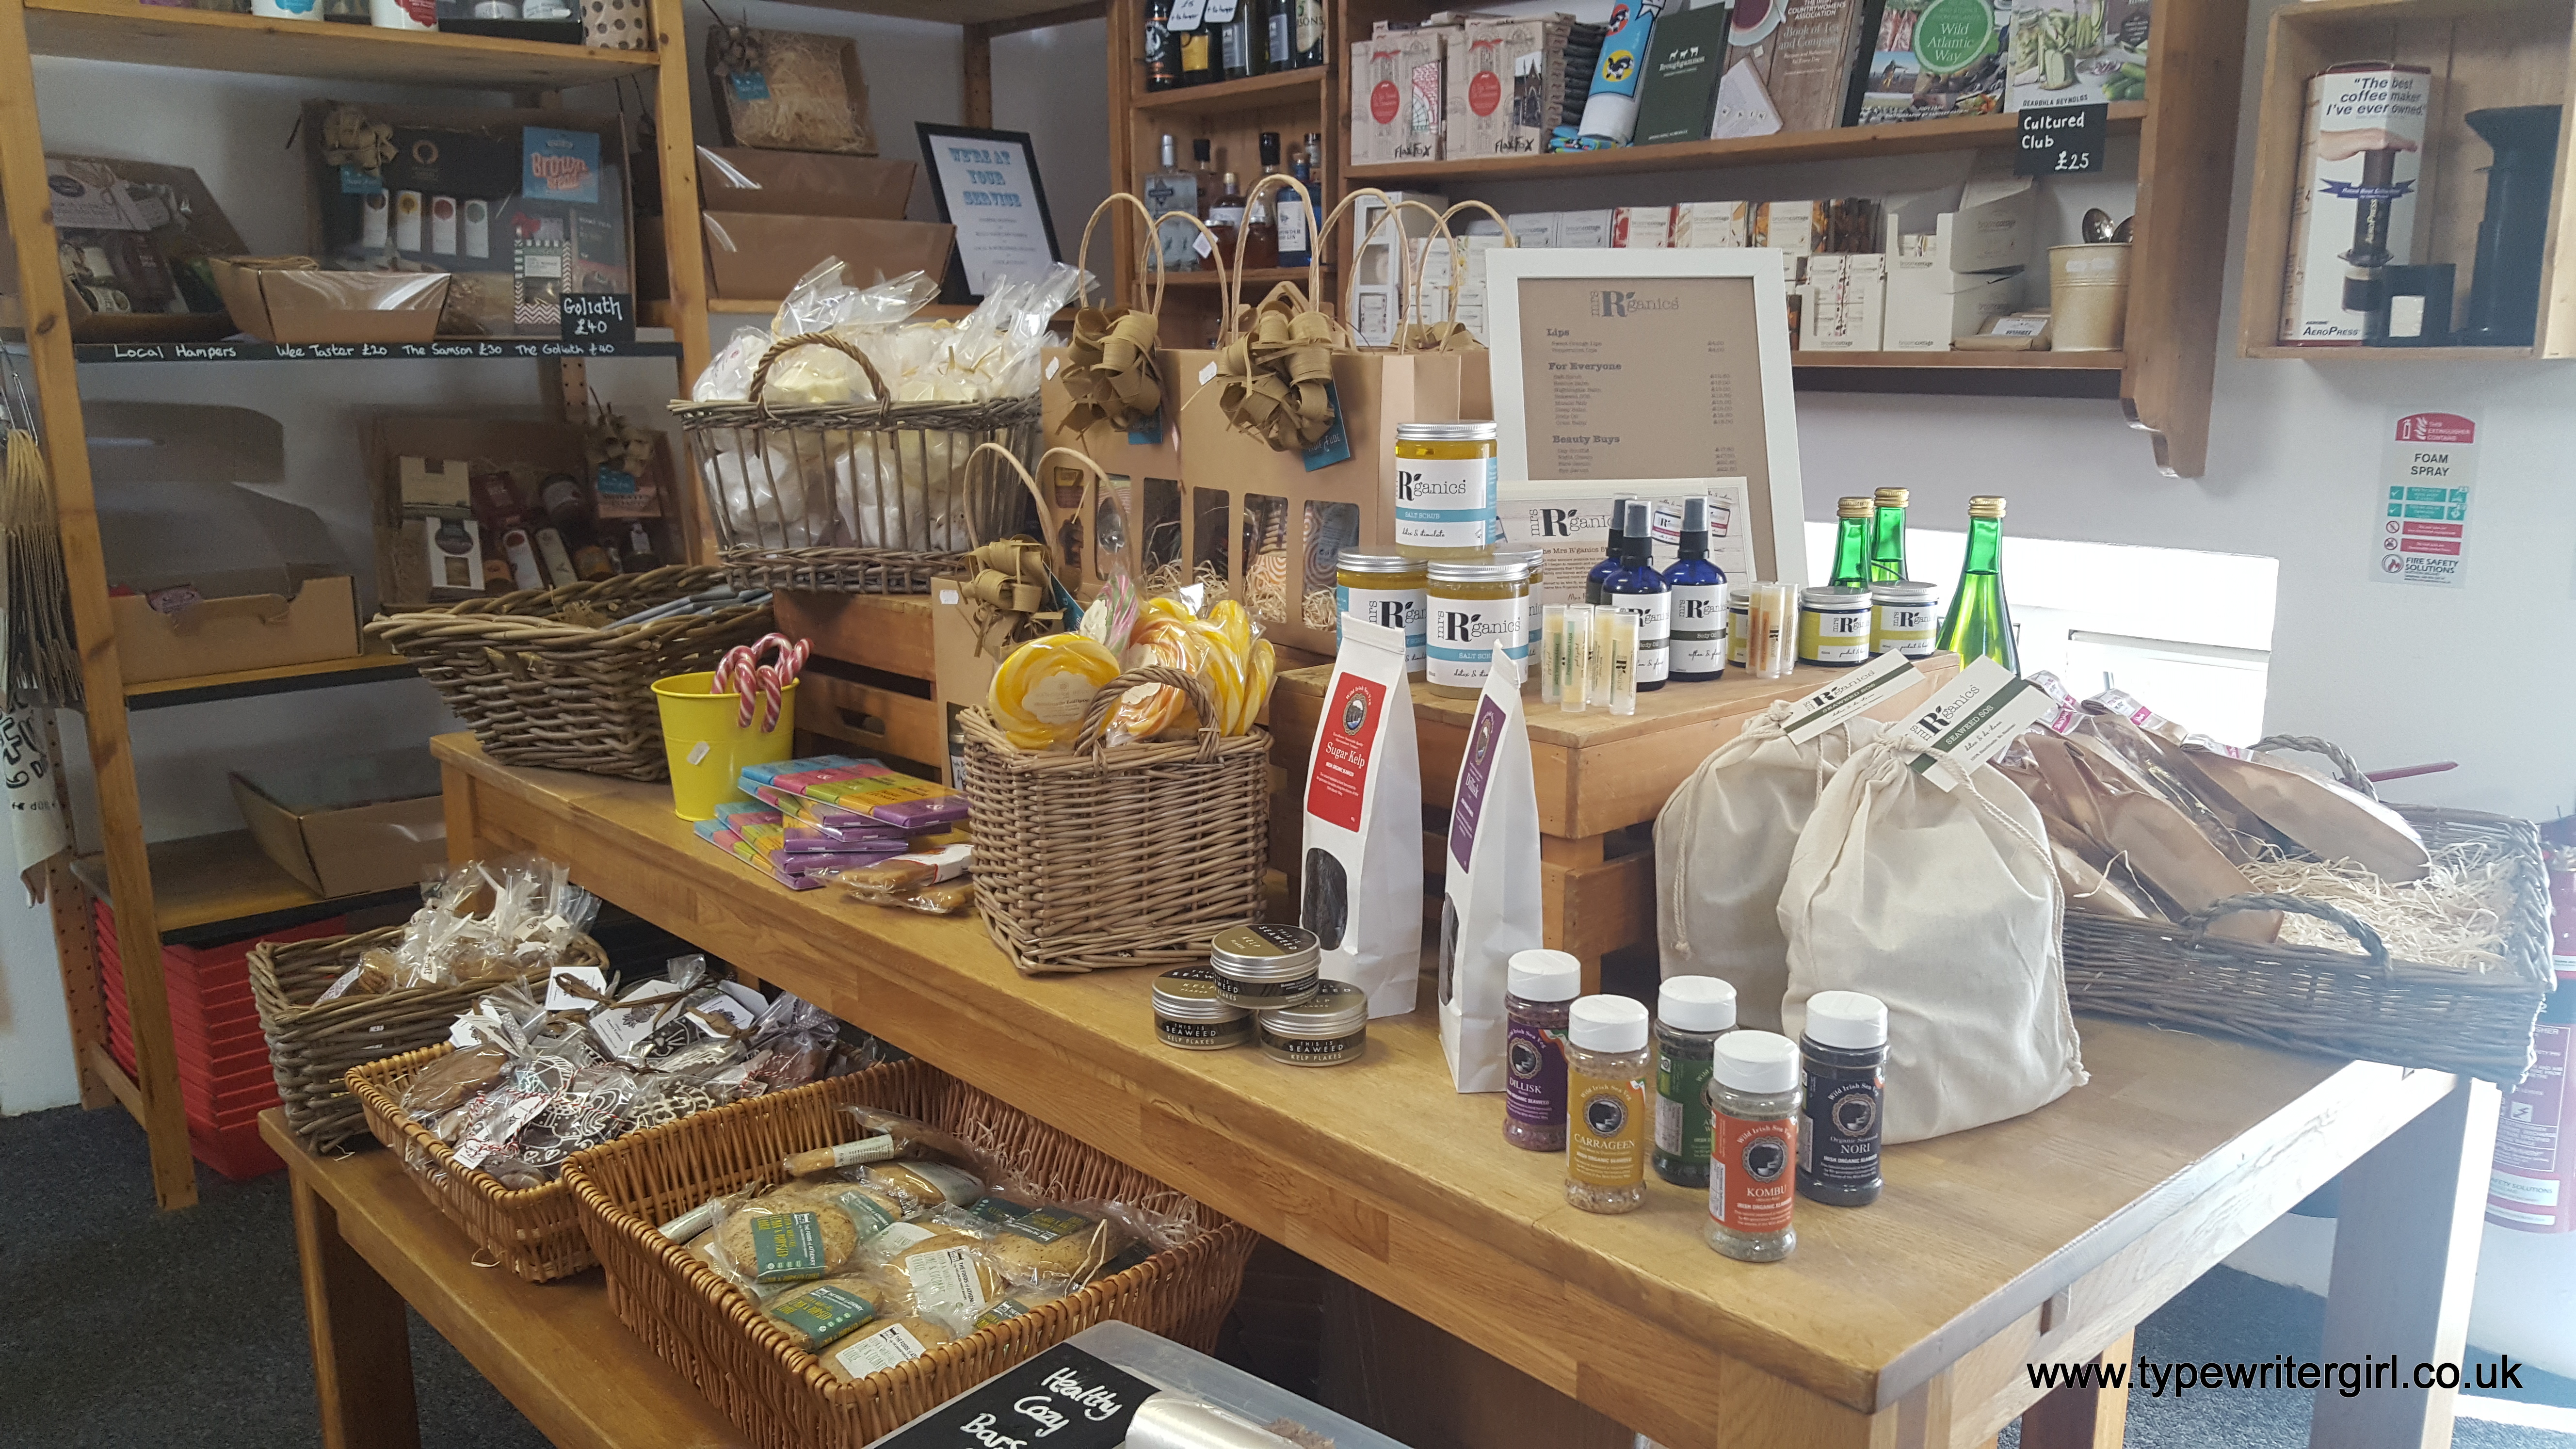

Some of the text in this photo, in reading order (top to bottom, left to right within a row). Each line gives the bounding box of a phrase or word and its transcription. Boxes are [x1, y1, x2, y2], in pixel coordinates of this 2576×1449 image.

[1795, 9, 1836, 20] ASSOCIATION
[1784, 24, 1809, 37] Book
[1811, 22, 1822, 33] of
[1941, 23, 1969, 35] Wild
[1778, 37, 1795, 50] and
[1927, 36, 1974, 48] Atlantic
[1935, 49, 1961, 64] Way
[2391, 77, 2413, 89] best
[2056, 95, 2088, 105] REYNOLDS
[2340, 90, 2421, 102] coffee maker
[2326, 104, 2352, 115] I've
[2357, 104, 2389, 114] ever
[2024, 112, 2085, 130] Cultured
[2021, 135, 2054, 149] Club
[2054, 150, 2090, 171] £25
[966, 170, 1006, 185] YOUR
[962, 191, 1022, 208] SERVICE
[564, 297, 622, 321] Goliath
[1590, 290, 1600, 317] mrs
[575, 319, 607, 336] £40
[1546, 328, 1570, 338] Lips
[113, 343, 237, 360] Local Hampers
[275, 343, 387, 358] Wee Taster £20
[402, 343, 502, 355] The Samson £30
[515, 344, 538, 356] The
[589, 344, 615, 354] £40
[1548, 362, 1622, 372] For Everyone
[1553, 435, 1621, 445] Beauty Buys
[2414, 453, 2449, 464] FOAM
[2410, 466, 2449, 477] SPRAY
[1529, 509, 1540, 537] mrs
[1569, 547, 1599, 556] R'ganics
[2405, 557, 2459, 567] FIRE SAFETY
[2405, 564, 2455, 574] SOLUTIONS
[1345, 689, 1355, 700] Wild
[1822, 683, 1876, 713] SEAWEED SOS
[1803, 701, 1816, 712] mrs
[1945, 704, 1995, 745] SEAWEED SOS
[1910, 724, 1933, 742] mrs
[1325, 741, 1349, 760] Sugar
[1348, 750, 1366, 770] Kelp
[1259, 926, 1298, 950] SEAWEED
[1277, 928, 1293, 938] THIS
[1230, 939, 1246, 950] FLAKES
[1241, 936, 1261, 948] KELP
[1213, 977, 1238, 993] AWEED
[1217, 989, 1237, 1001] FLAKES
[1166, 1025, 1217, 1037] SEAWEED
[1525, 1030, 1536, 1040] Sea
[1167, 1034, 1183, 1043] KELP
[1288, 1043, 1344, 1054] SEAWEED
[1313, 1052, 1342, 1061] FLAKES
[1695, 1068, 1710, 1082] Wild
[1509, 1077, 1542, 1095] DILLISK
[1827, 1082, 1871, 1101] Wild Irish Sea
[1580, 1088, 1592, 1099] Wild
[1610, 1085, 1623, 1094] Sea
[1623, 1091, 1632, 1102] Veg
[1737, 1125, 1784, 1144] Wild Irish Sea
[1574, 1133, 1635, 1150] CARRAGEEN
[1840, 1143, 1871, 1154] NORI
[1588, 1155, 1610, 1163] ORGANIC
[1746, 1185, 1787, 1197] KOMBU
[2512, 1182, 2553, 1194] SOLUTIONS
[1752, 1202, 1775, 1210] ORGANIC
[808, 1245, 816, 1266] ATHENRY
[848, 1301, 864, 1311] ATHENRY
[899, 1340, 910, 1351] FOODS
[1040, 1367, 1123, 1421] Healthy
[1014, 1395, 1070, 1438] Cozy
[960, 1412, 1027, 1449] Bars
